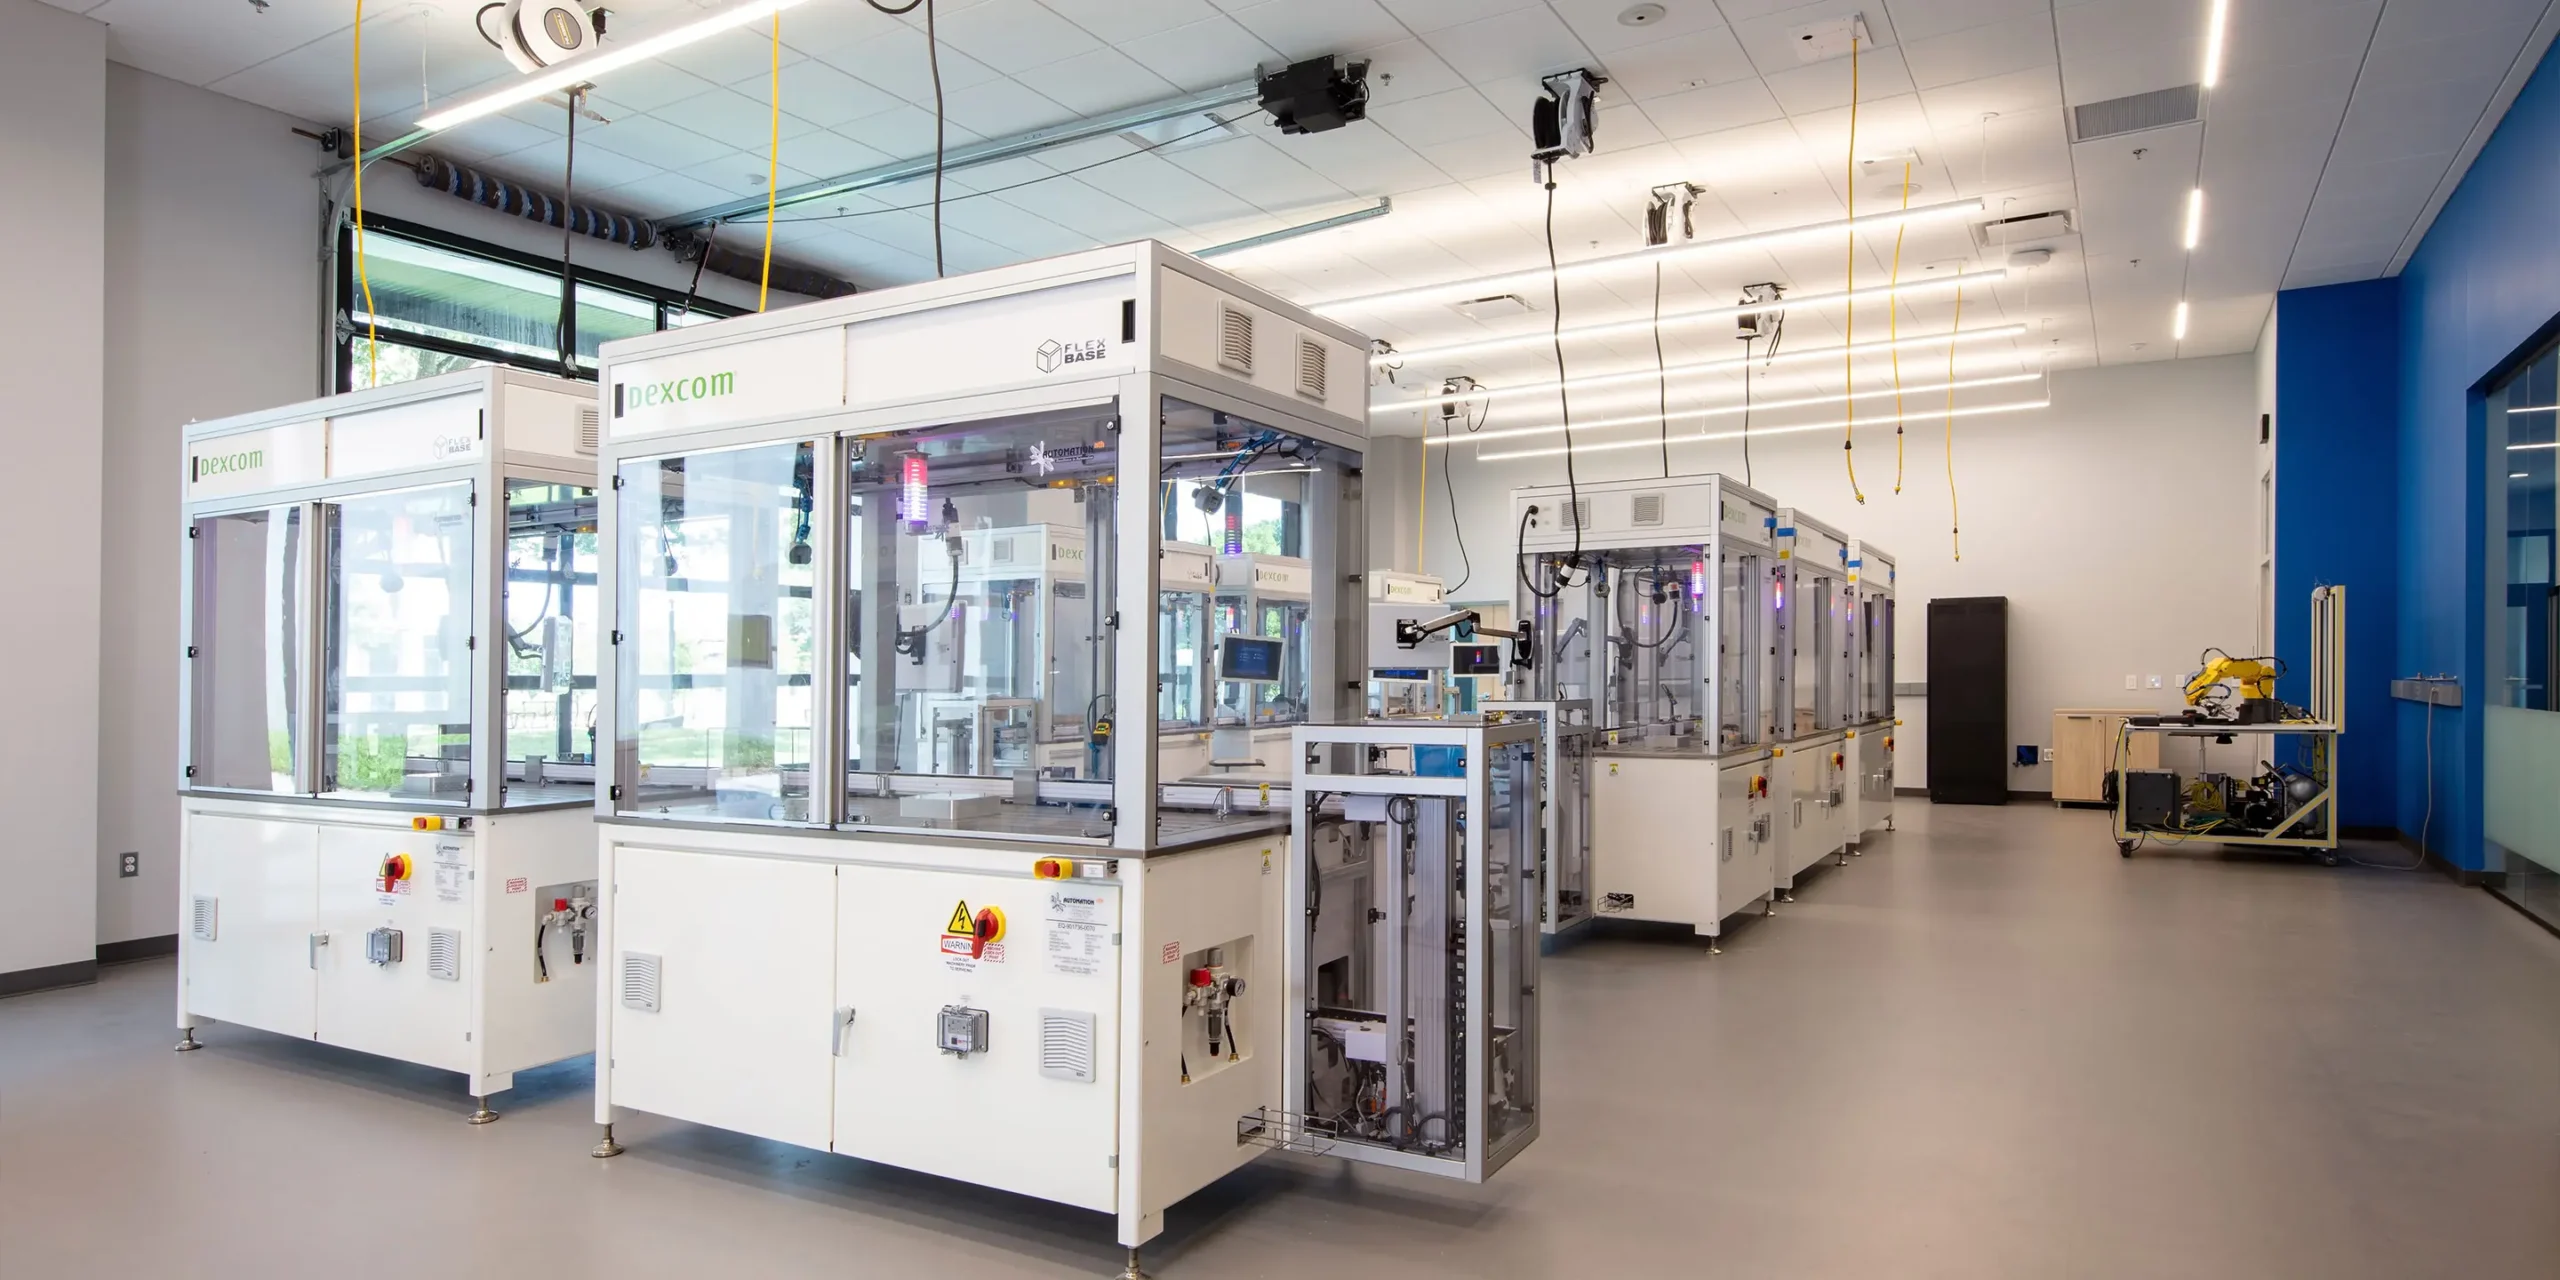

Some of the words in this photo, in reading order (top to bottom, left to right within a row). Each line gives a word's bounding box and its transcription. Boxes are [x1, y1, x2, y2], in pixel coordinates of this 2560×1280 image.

[1064, 338, 1106, 354] FLEX
[1064, 349, 1106, 364] BASE
[629, 371, 734, 409] Dexcom
[448, 444, 471, 454] BASE
[1042, 444, 1095, 459] AUTOMATION
[201, 450, 263, 477] Dexcom
[1058, 546, 1084, 561] Dexc
[1063, 897, 1095, 906] AUTOMATION
[944, 940, 974, 951] WARNIN
